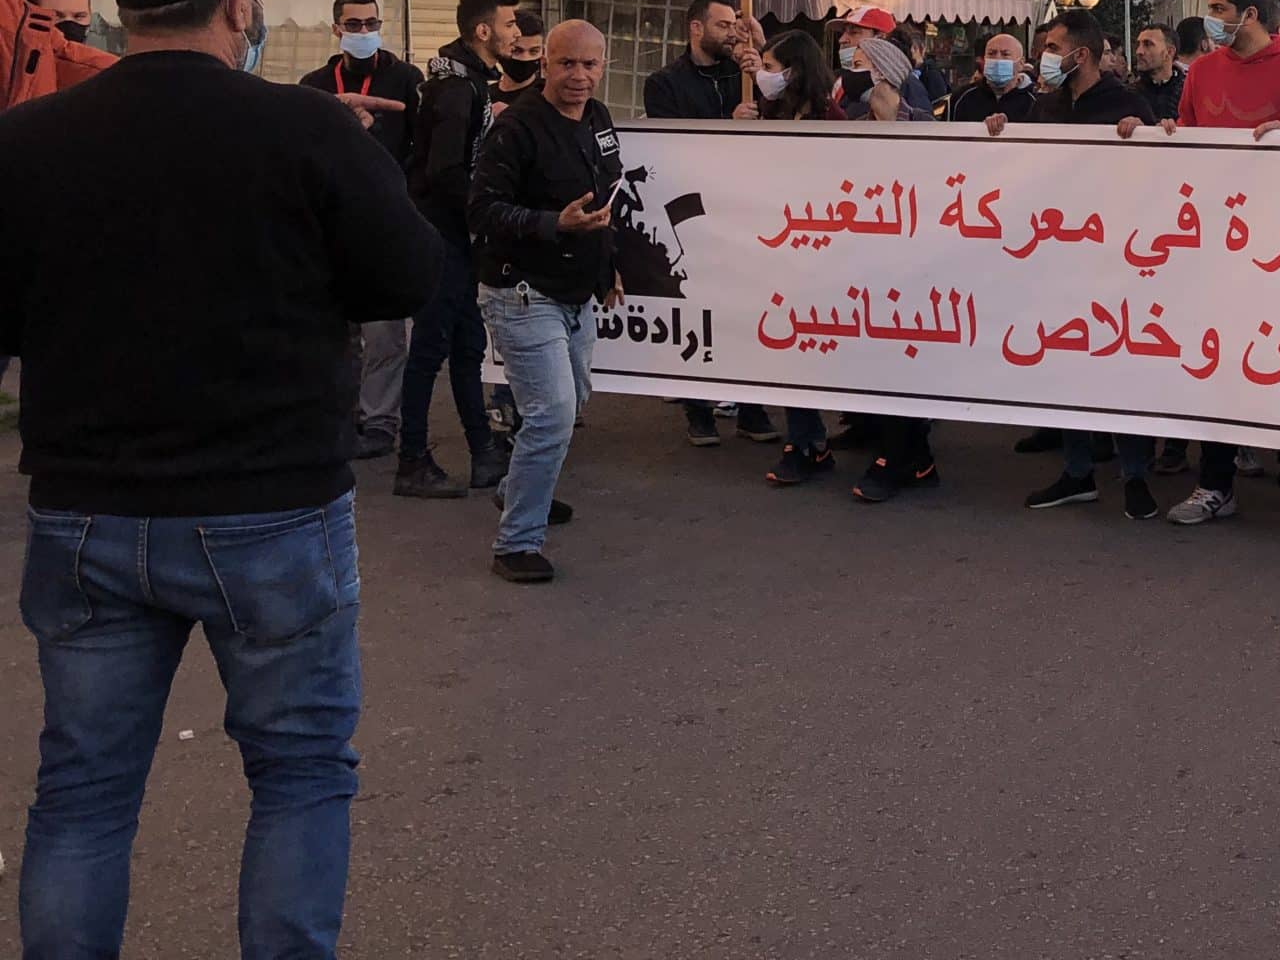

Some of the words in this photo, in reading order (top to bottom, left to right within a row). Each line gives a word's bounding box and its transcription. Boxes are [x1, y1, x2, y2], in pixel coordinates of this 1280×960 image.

[757, 179, 918, 251] التغيير
[939, 172, 1105, 260] معركة
[1123, 182, 1202, 278] في
[627, 304, 713, 363] إرادة
[756, 287, 977, 358] اللبنانيين
[1001, 300, 1221, 381] وخلاص
